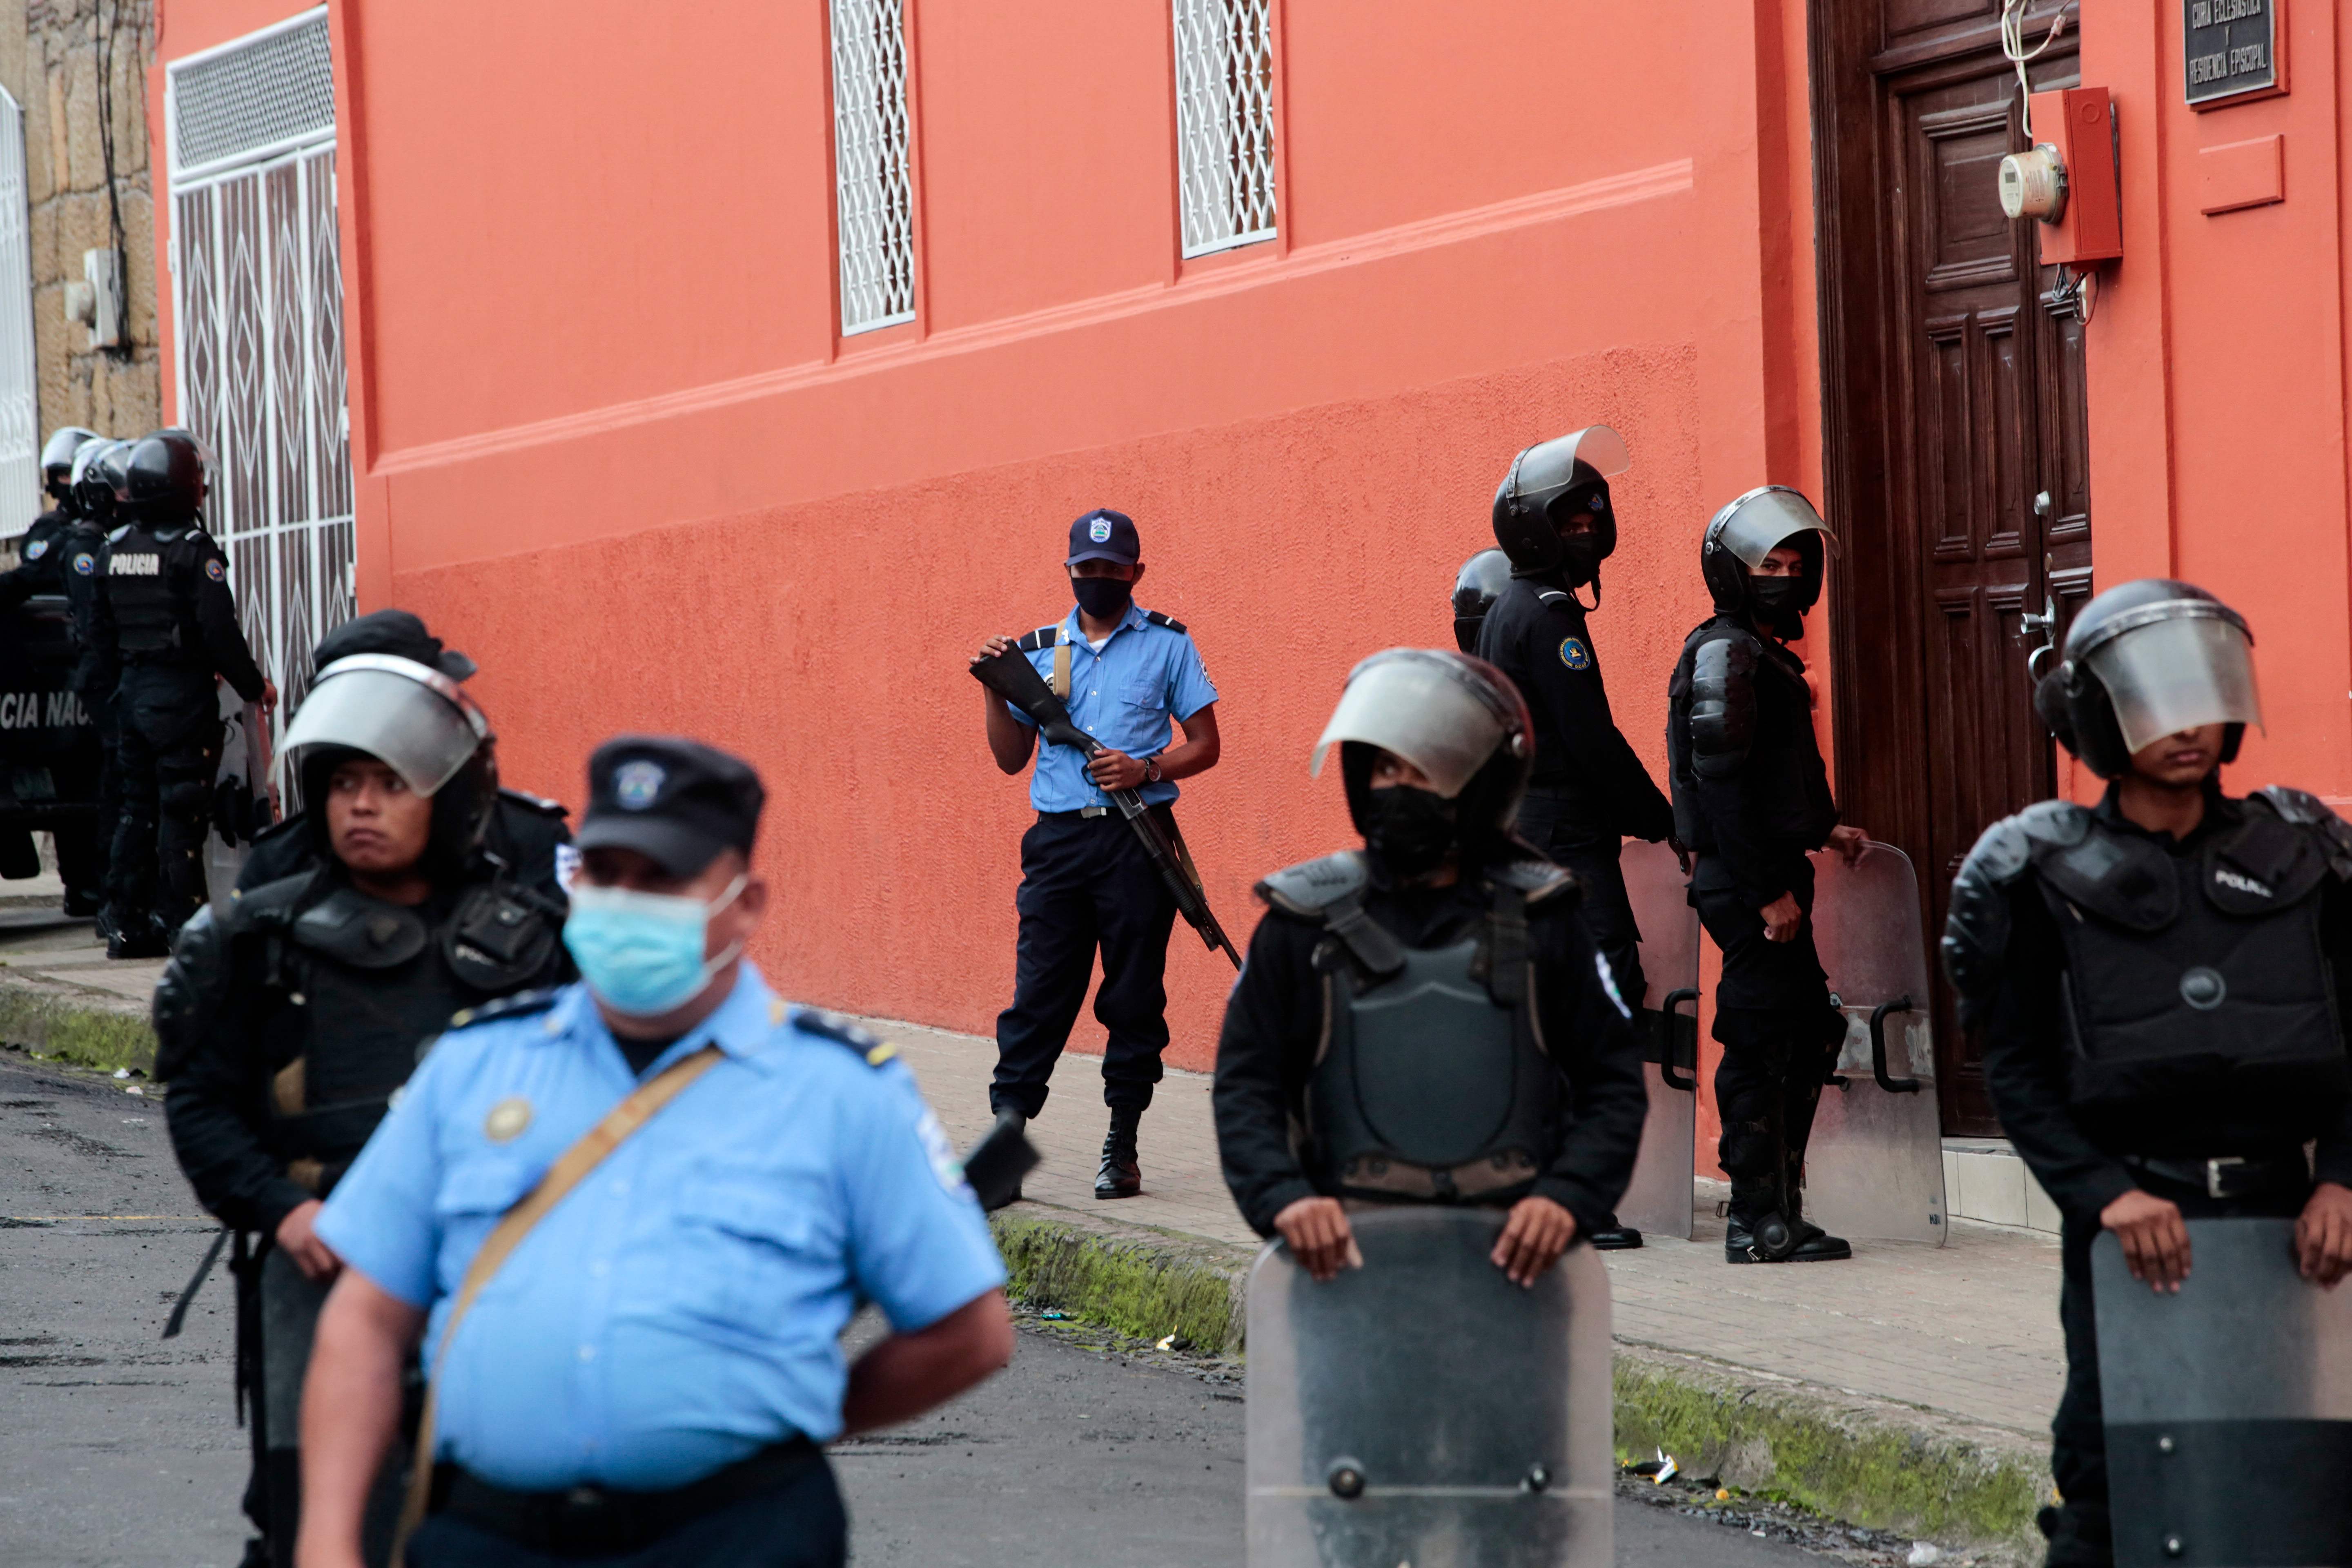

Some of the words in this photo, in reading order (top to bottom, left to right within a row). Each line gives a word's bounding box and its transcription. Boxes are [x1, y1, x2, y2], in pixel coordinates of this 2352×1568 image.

[2192, 1, 2212, 29] CURIA
[2225, 25, 2230, 46] Y
[2190, 52, 2227, 85] RESIDENCIA
[2231, 42, 2266, 75] EPISCOPAL
[109, 553, 159, 575] POLICIA
[0, 692, 38, 729] CIA
